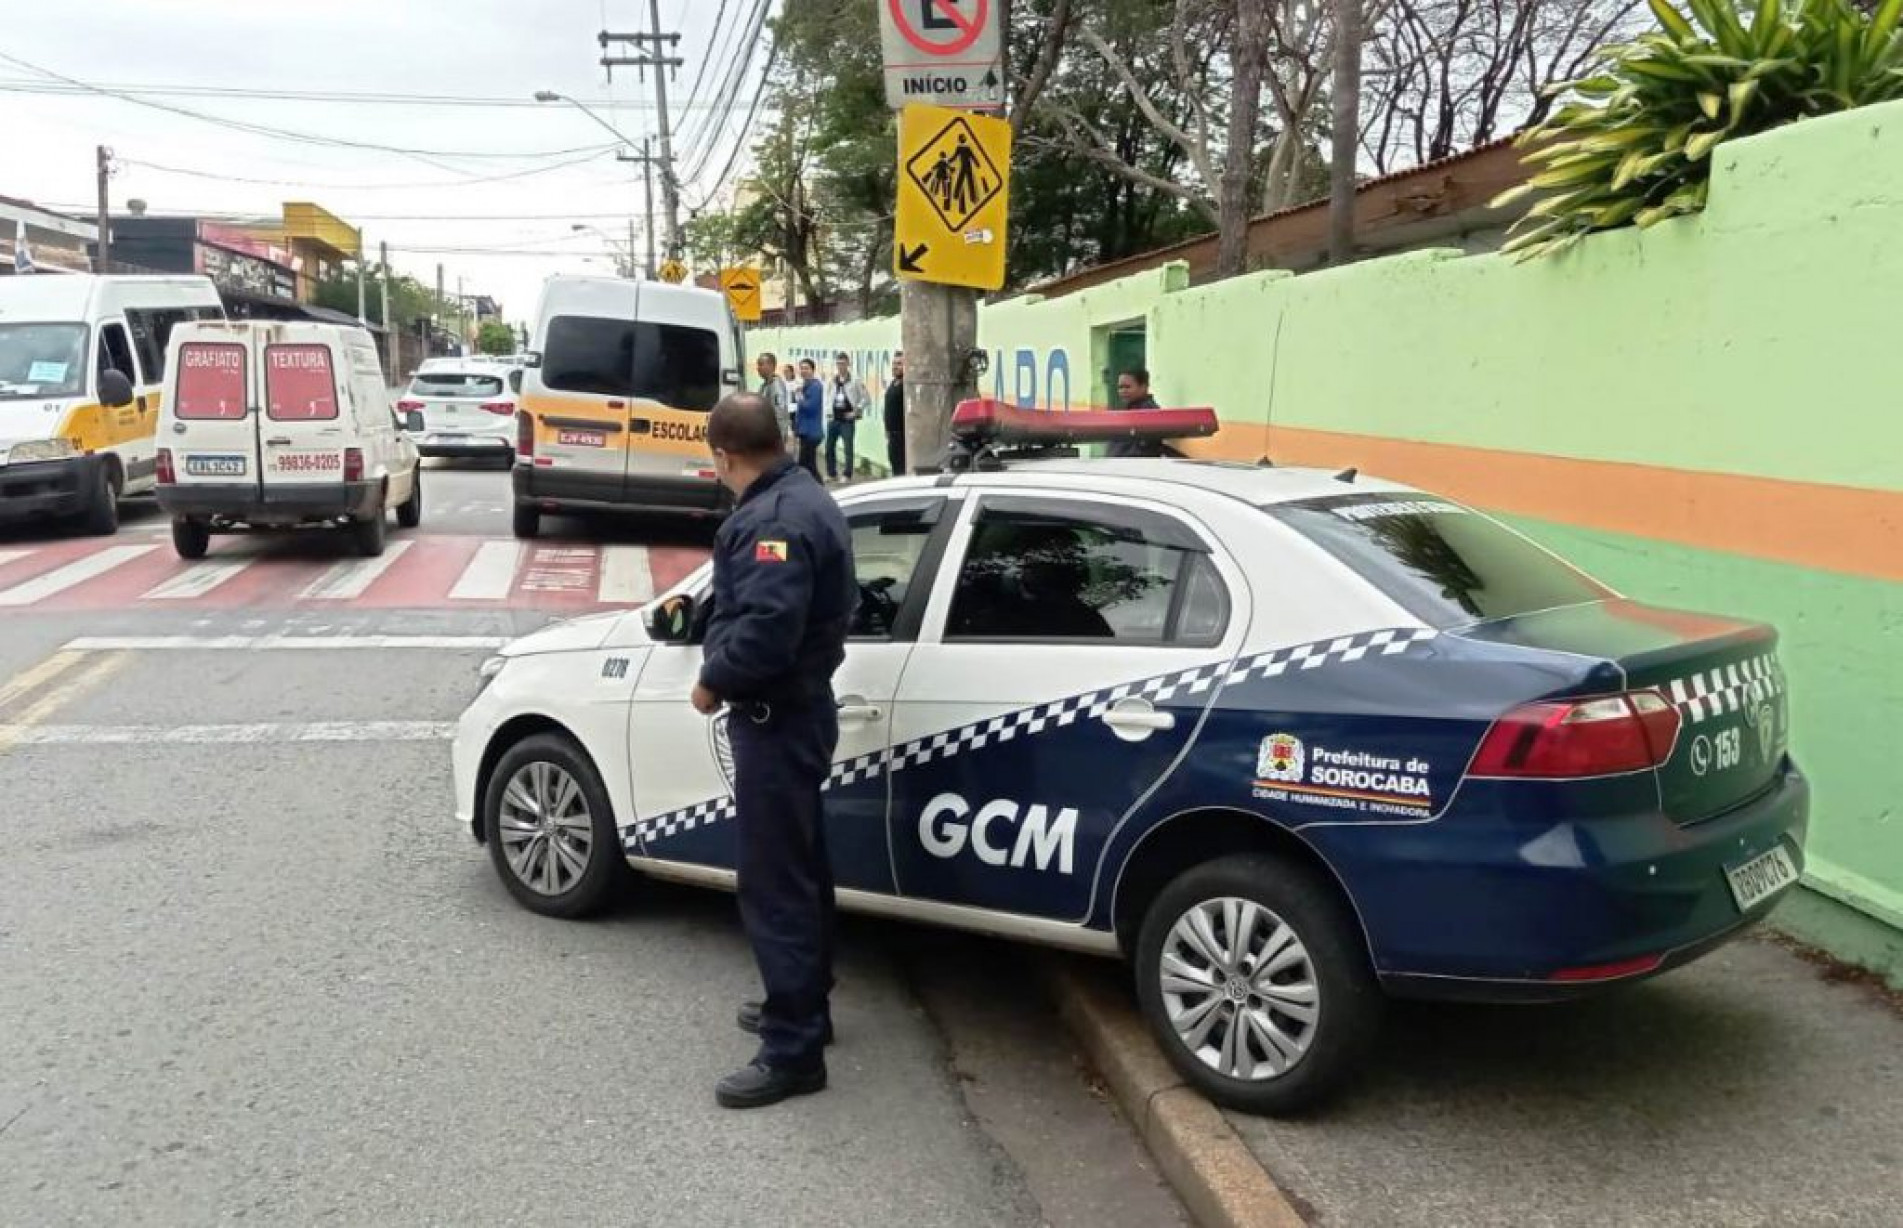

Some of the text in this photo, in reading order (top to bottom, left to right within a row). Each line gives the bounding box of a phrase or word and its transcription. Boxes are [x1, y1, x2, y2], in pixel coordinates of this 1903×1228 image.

[903, 73, 967, 94] INÍCIO
[185, 350, 239, 367] GRAFIATO
[271, 352, 326, 368] TEXTURA
[1313, 746, 1429, 774] Prefeitura de
[1714, 726, 1740, 770] 153
[1311, 766, 1430, 796] SOROCABA
[918, 792, 1079, 875] GCM
